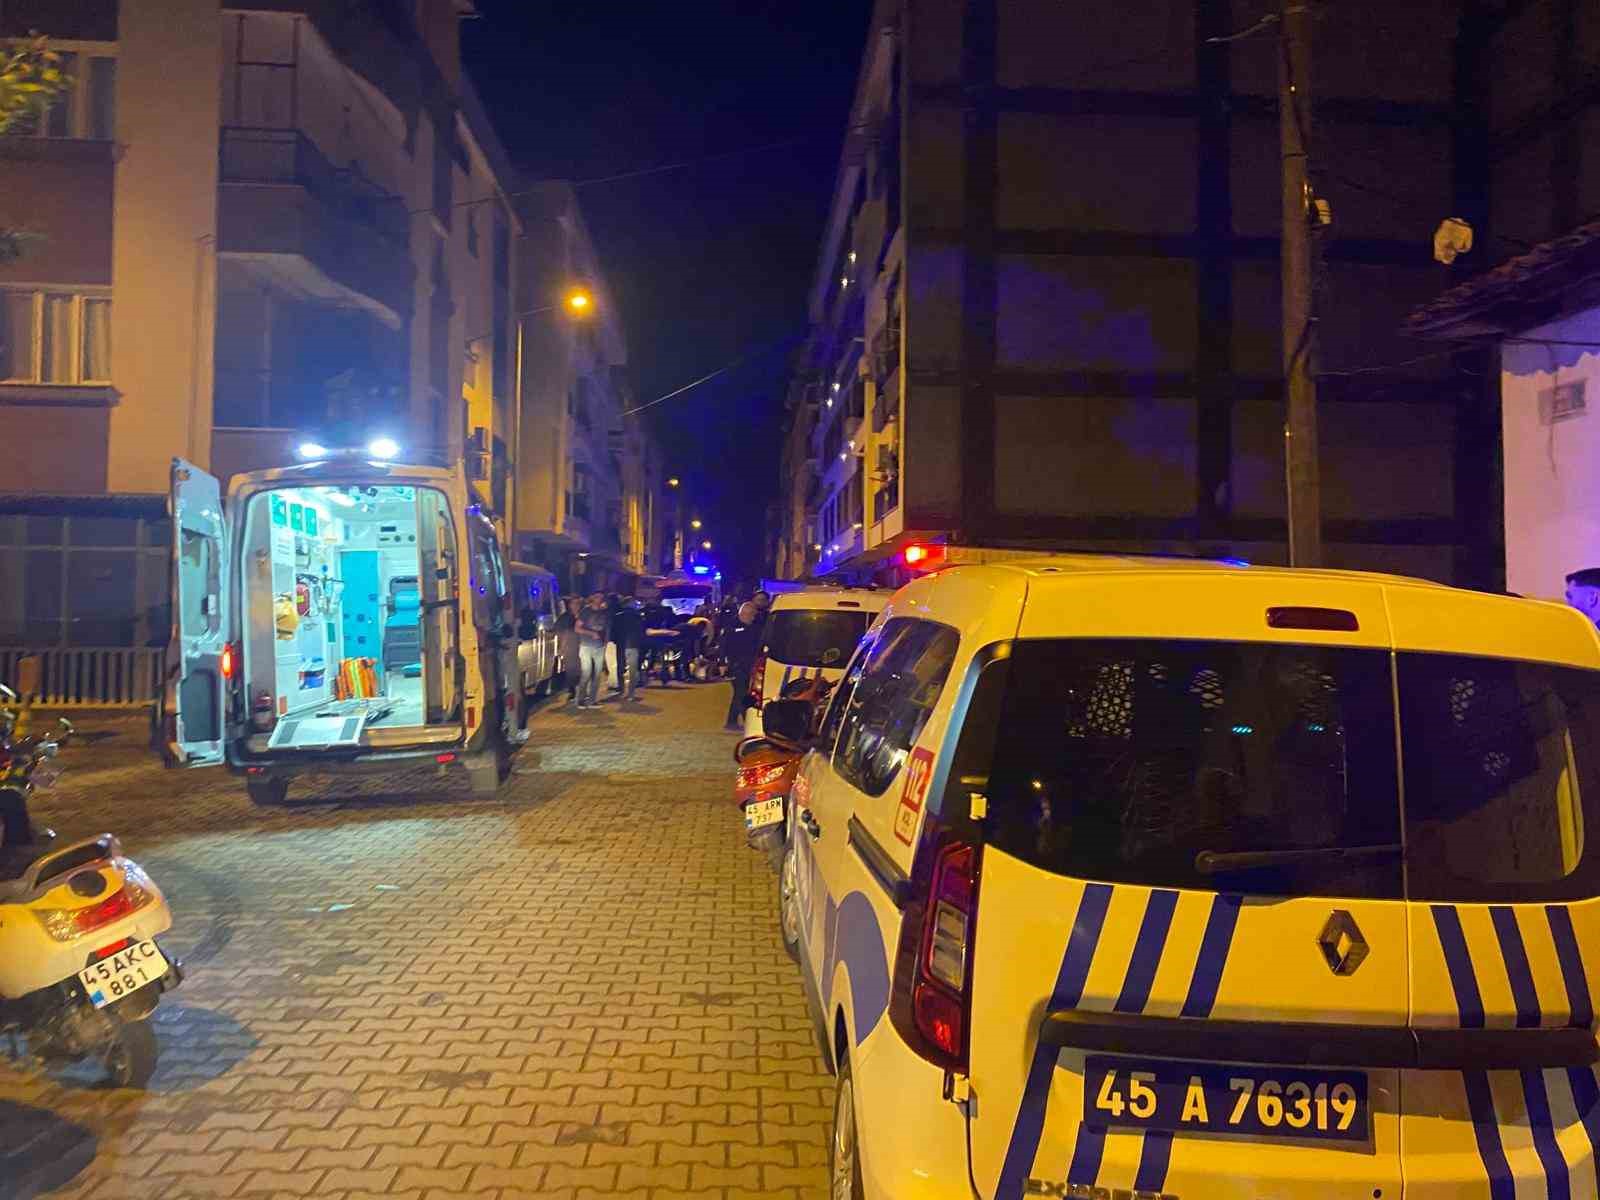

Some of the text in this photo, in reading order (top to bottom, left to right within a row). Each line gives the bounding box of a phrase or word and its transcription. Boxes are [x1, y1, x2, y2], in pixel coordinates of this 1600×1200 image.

[110, 967, 148, 996] 881
[1095, 1069, 1357, 1130] 45 A 76319
